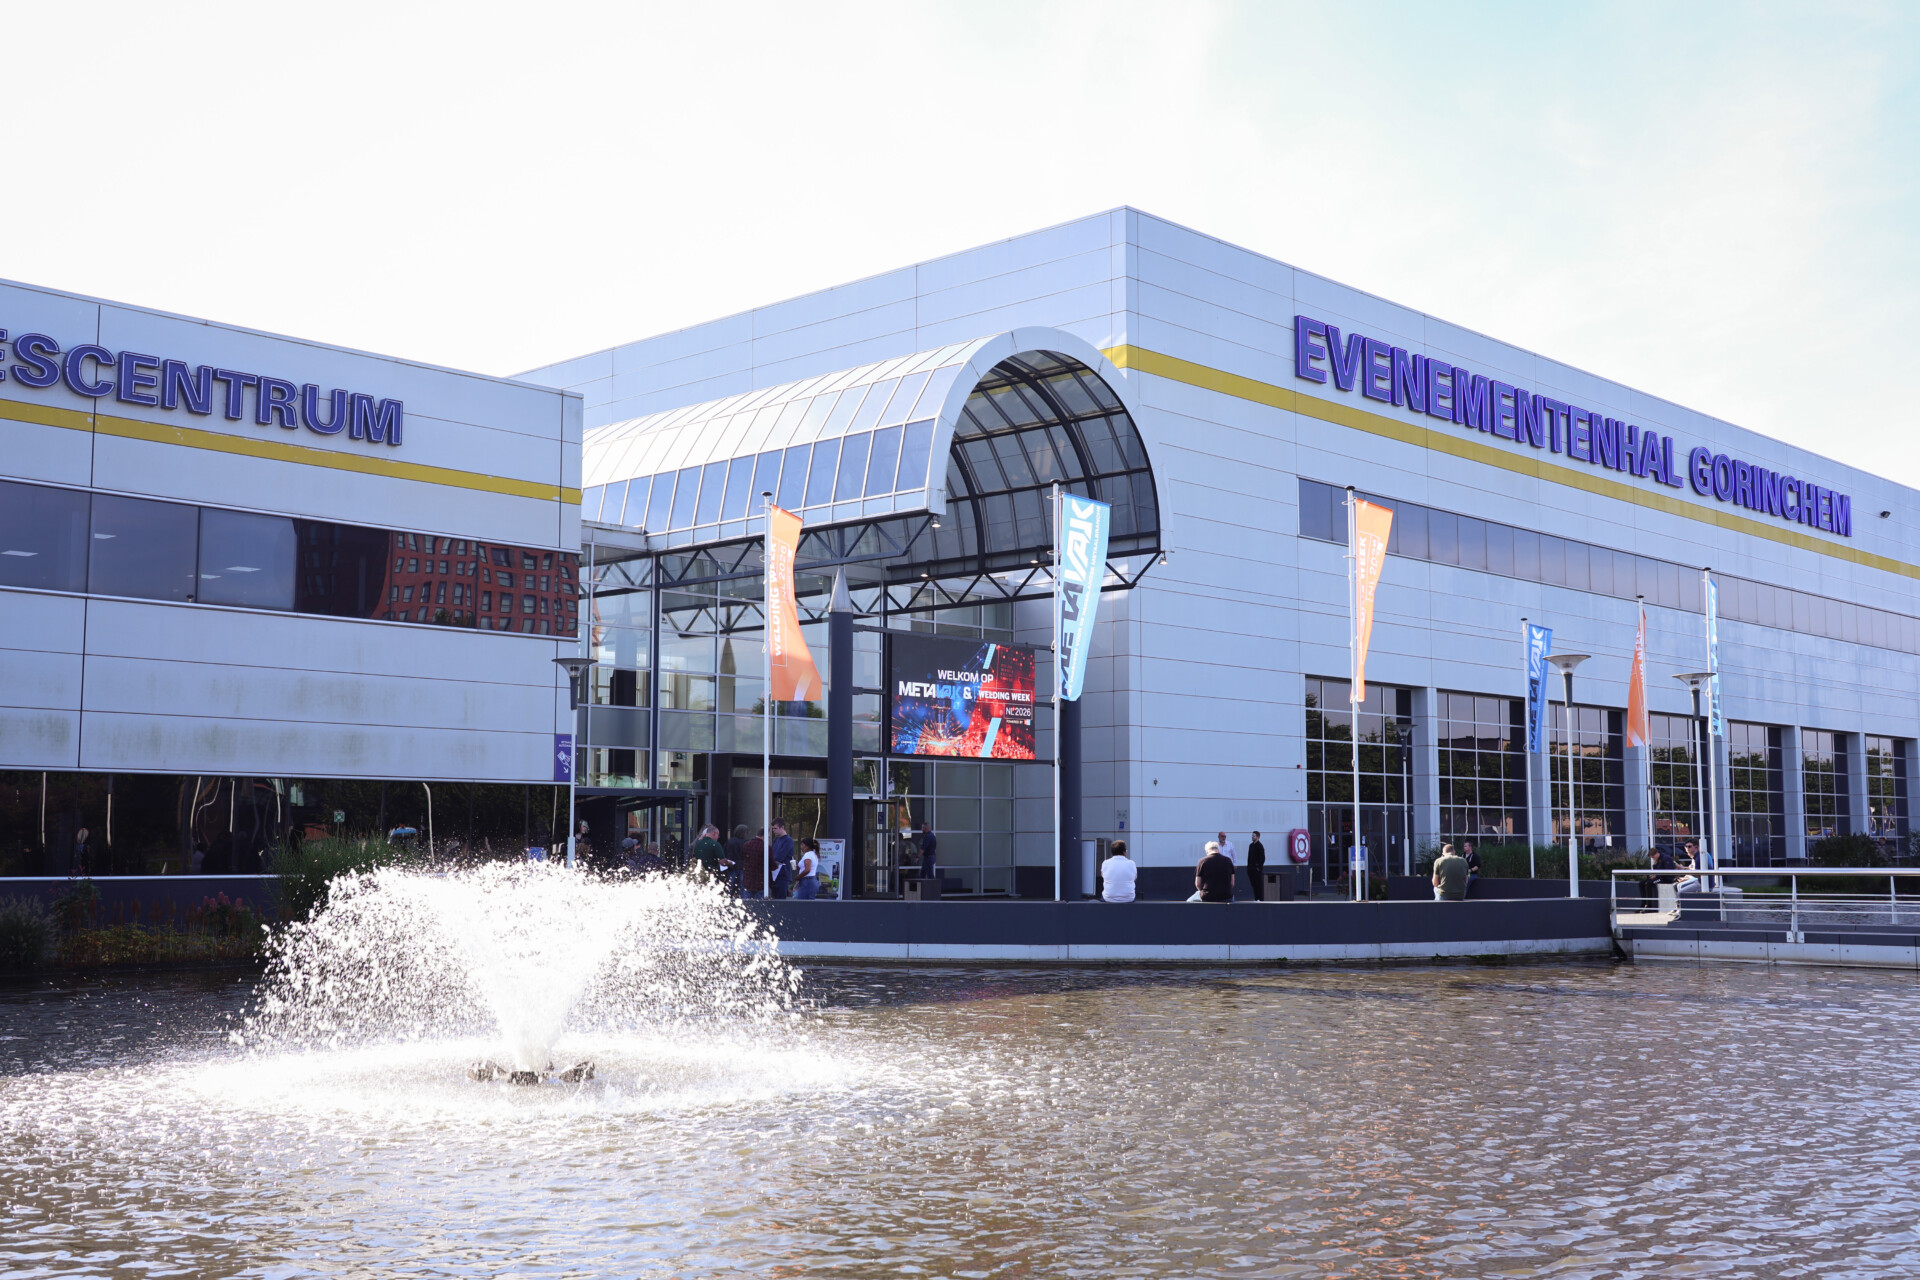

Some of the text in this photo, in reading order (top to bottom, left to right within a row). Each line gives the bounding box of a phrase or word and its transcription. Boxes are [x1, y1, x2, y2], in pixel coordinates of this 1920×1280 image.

[0, 328, 403, 447] SCENTRUM
[1294, 315, 1853, 538] EVENEMENTENHAL GORINCHEM
[778, 545, 787, 581] 2026
[1359, 537, 1367, 579] WEEK
[769, 587, 781, 657] WELDING
[937, 669, 994, 683] WELKOM OP
[963, 686, 972, 699] &
[979, 690, 1010, 701] WELDING
[1012, 693, 1031, 702] WEEK
[1015, 707, 1031, 717] 2026
